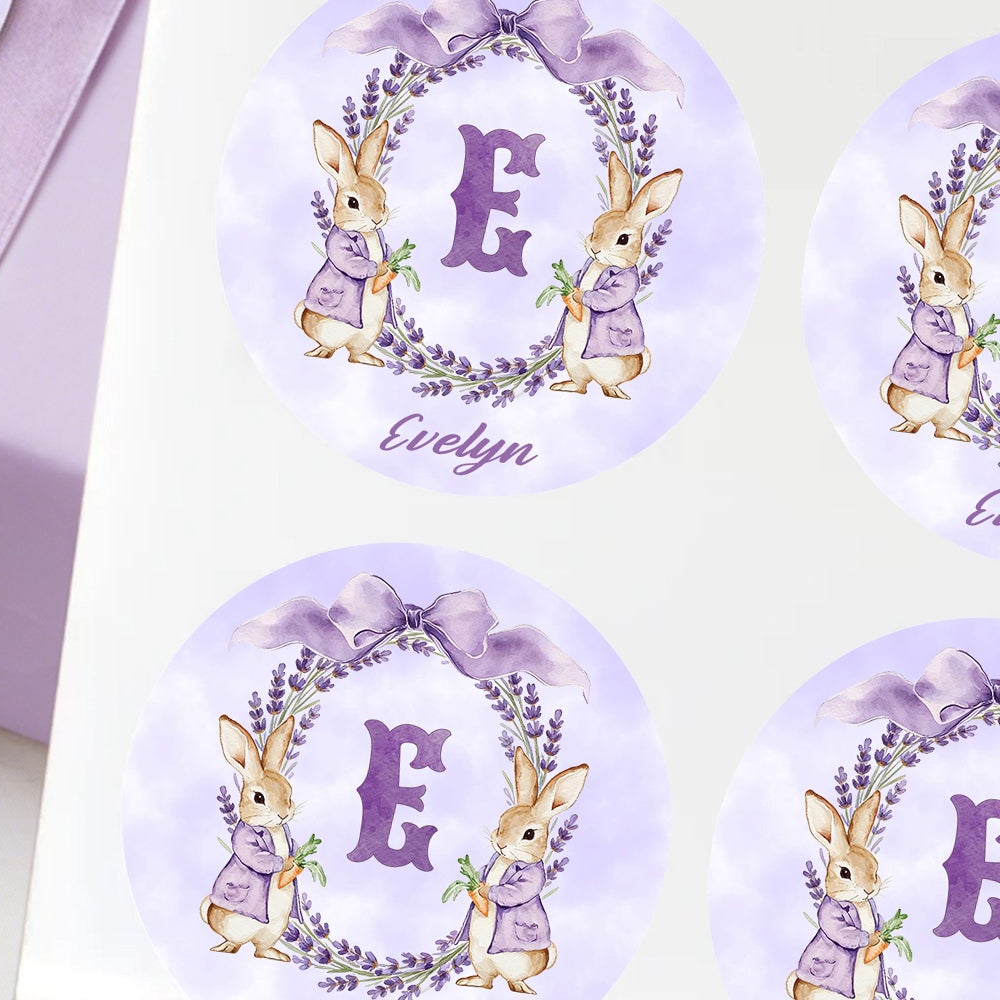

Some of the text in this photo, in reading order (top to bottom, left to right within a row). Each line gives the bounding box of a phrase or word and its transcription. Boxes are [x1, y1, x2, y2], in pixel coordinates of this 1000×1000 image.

[441, 124, 546, 277] E
[380, 414, 538, 475] Evelyn
[347, 719, 452, 872] E
